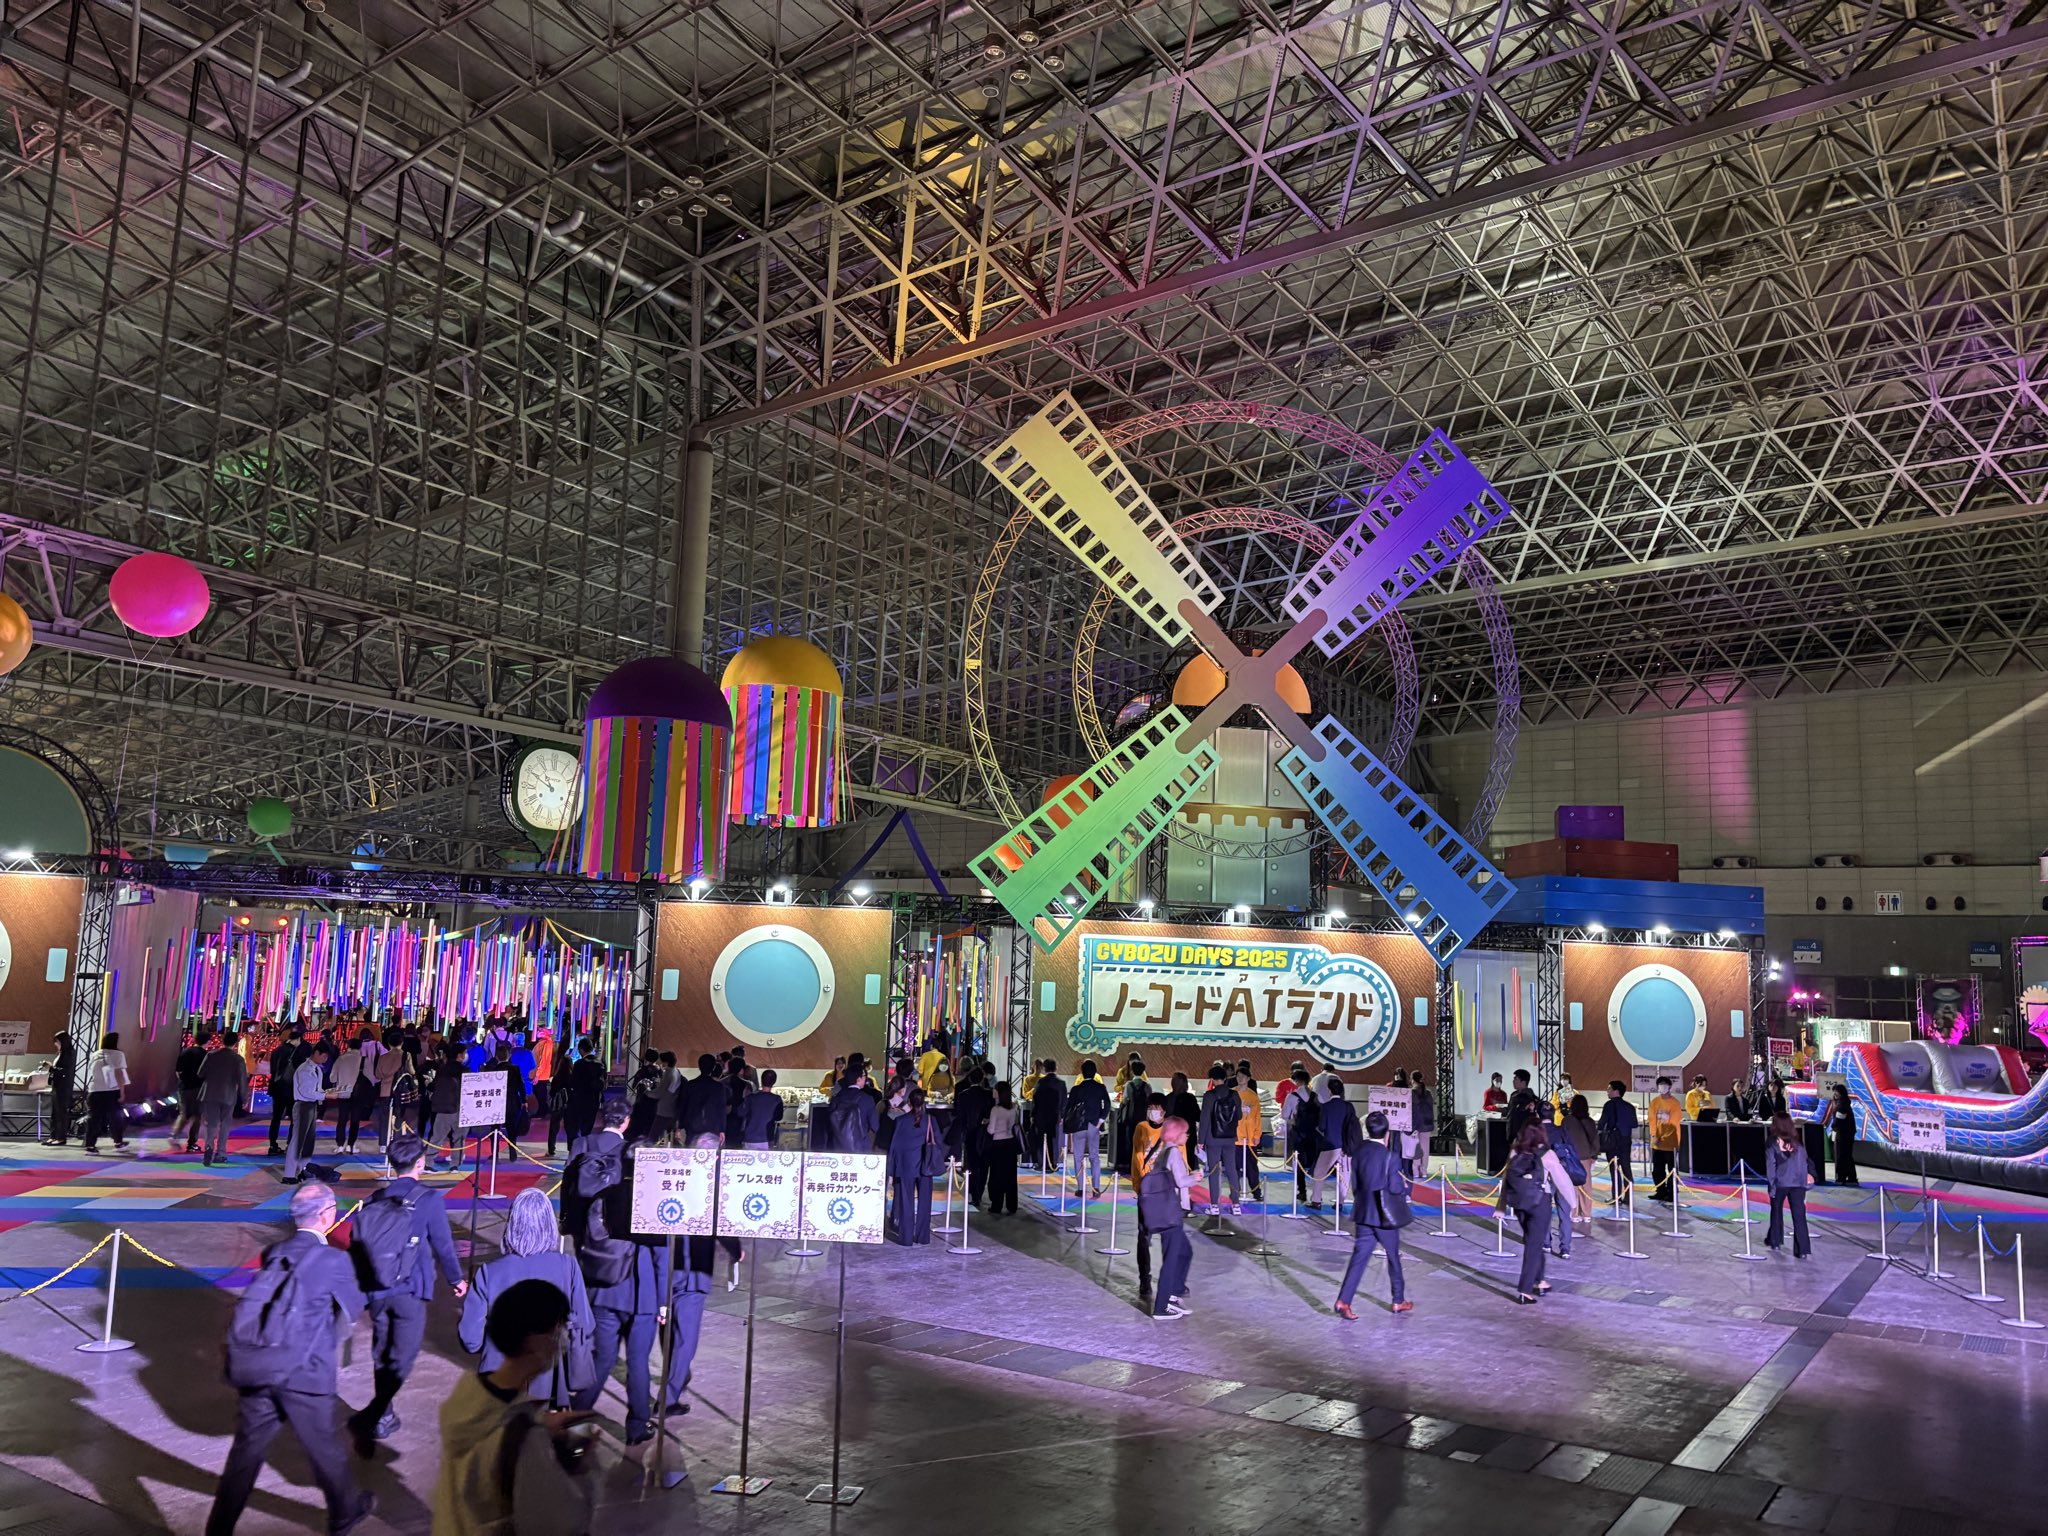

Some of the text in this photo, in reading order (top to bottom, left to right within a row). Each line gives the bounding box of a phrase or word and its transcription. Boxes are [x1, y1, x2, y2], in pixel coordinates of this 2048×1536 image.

[1811, 942, 1817, 950] 4
[1096, 942, 1288, 968] CYBOZU DAYS 2025
[1097, 981, 1374, 1032] ノーコードAIランド
[1772, 1043, 1791, 1053] 出口
[466, 1088, 502, 1098] 一般来場者
[475, 1099, 492, 1108] 受付
[1903, 1121, 1940, 1130] 一般来場者
[1913, 1130, 1931, 1138] 受付
[657, 1168, 692, 1177] 一般来場者
[830, 1171, 858, 1183] 受講票
[737, 1173, 783, 1185] プレス受付
[661, 1180, 686, 1191] 受付
[806, 1182, 881, 1195] 再発行カウンター
